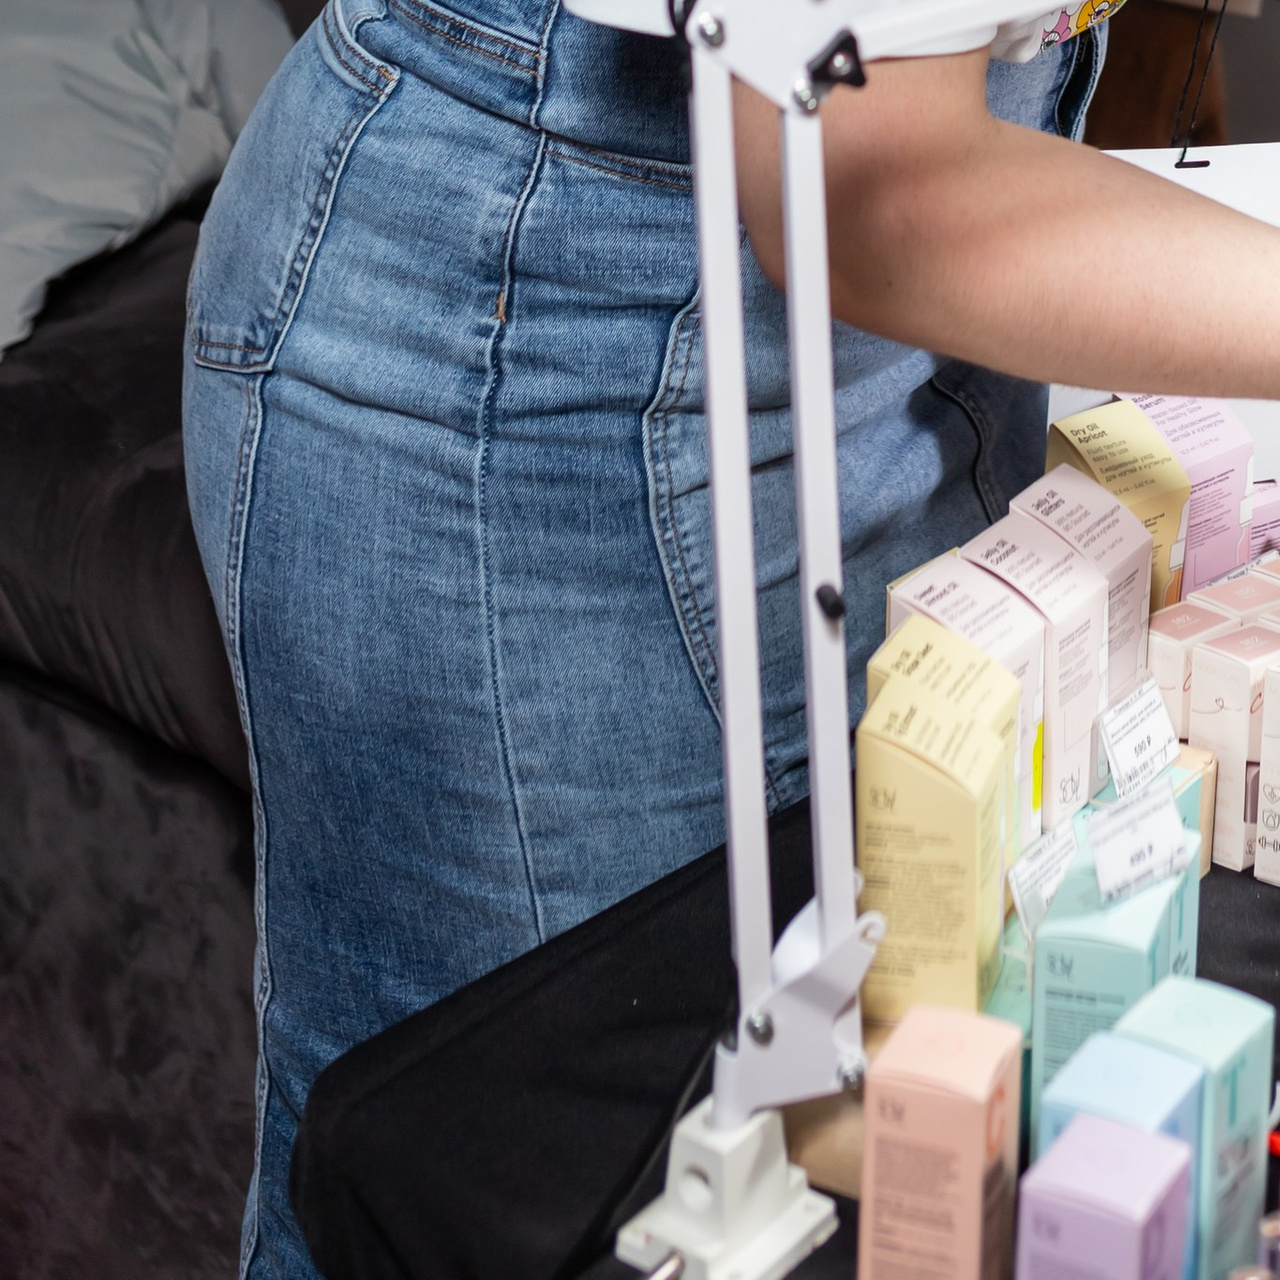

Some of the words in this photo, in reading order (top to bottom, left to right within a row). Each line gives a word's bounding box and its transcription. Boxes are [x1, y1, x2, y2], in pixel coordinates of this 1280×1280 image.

[1139, 396, 1166, 411] Serum
[1070, 425, 1087, 437] Dry
[1085, 422, 1100, 432] Oil
[1078, 429, 1108, 445] Apricot
[1103, 438, 1126, 450] texture
[1143, 456, 1172, 470] кутикулы
[1134, 740, 1147, 758] 590
[1146, 734, 1152, 747] ₽
